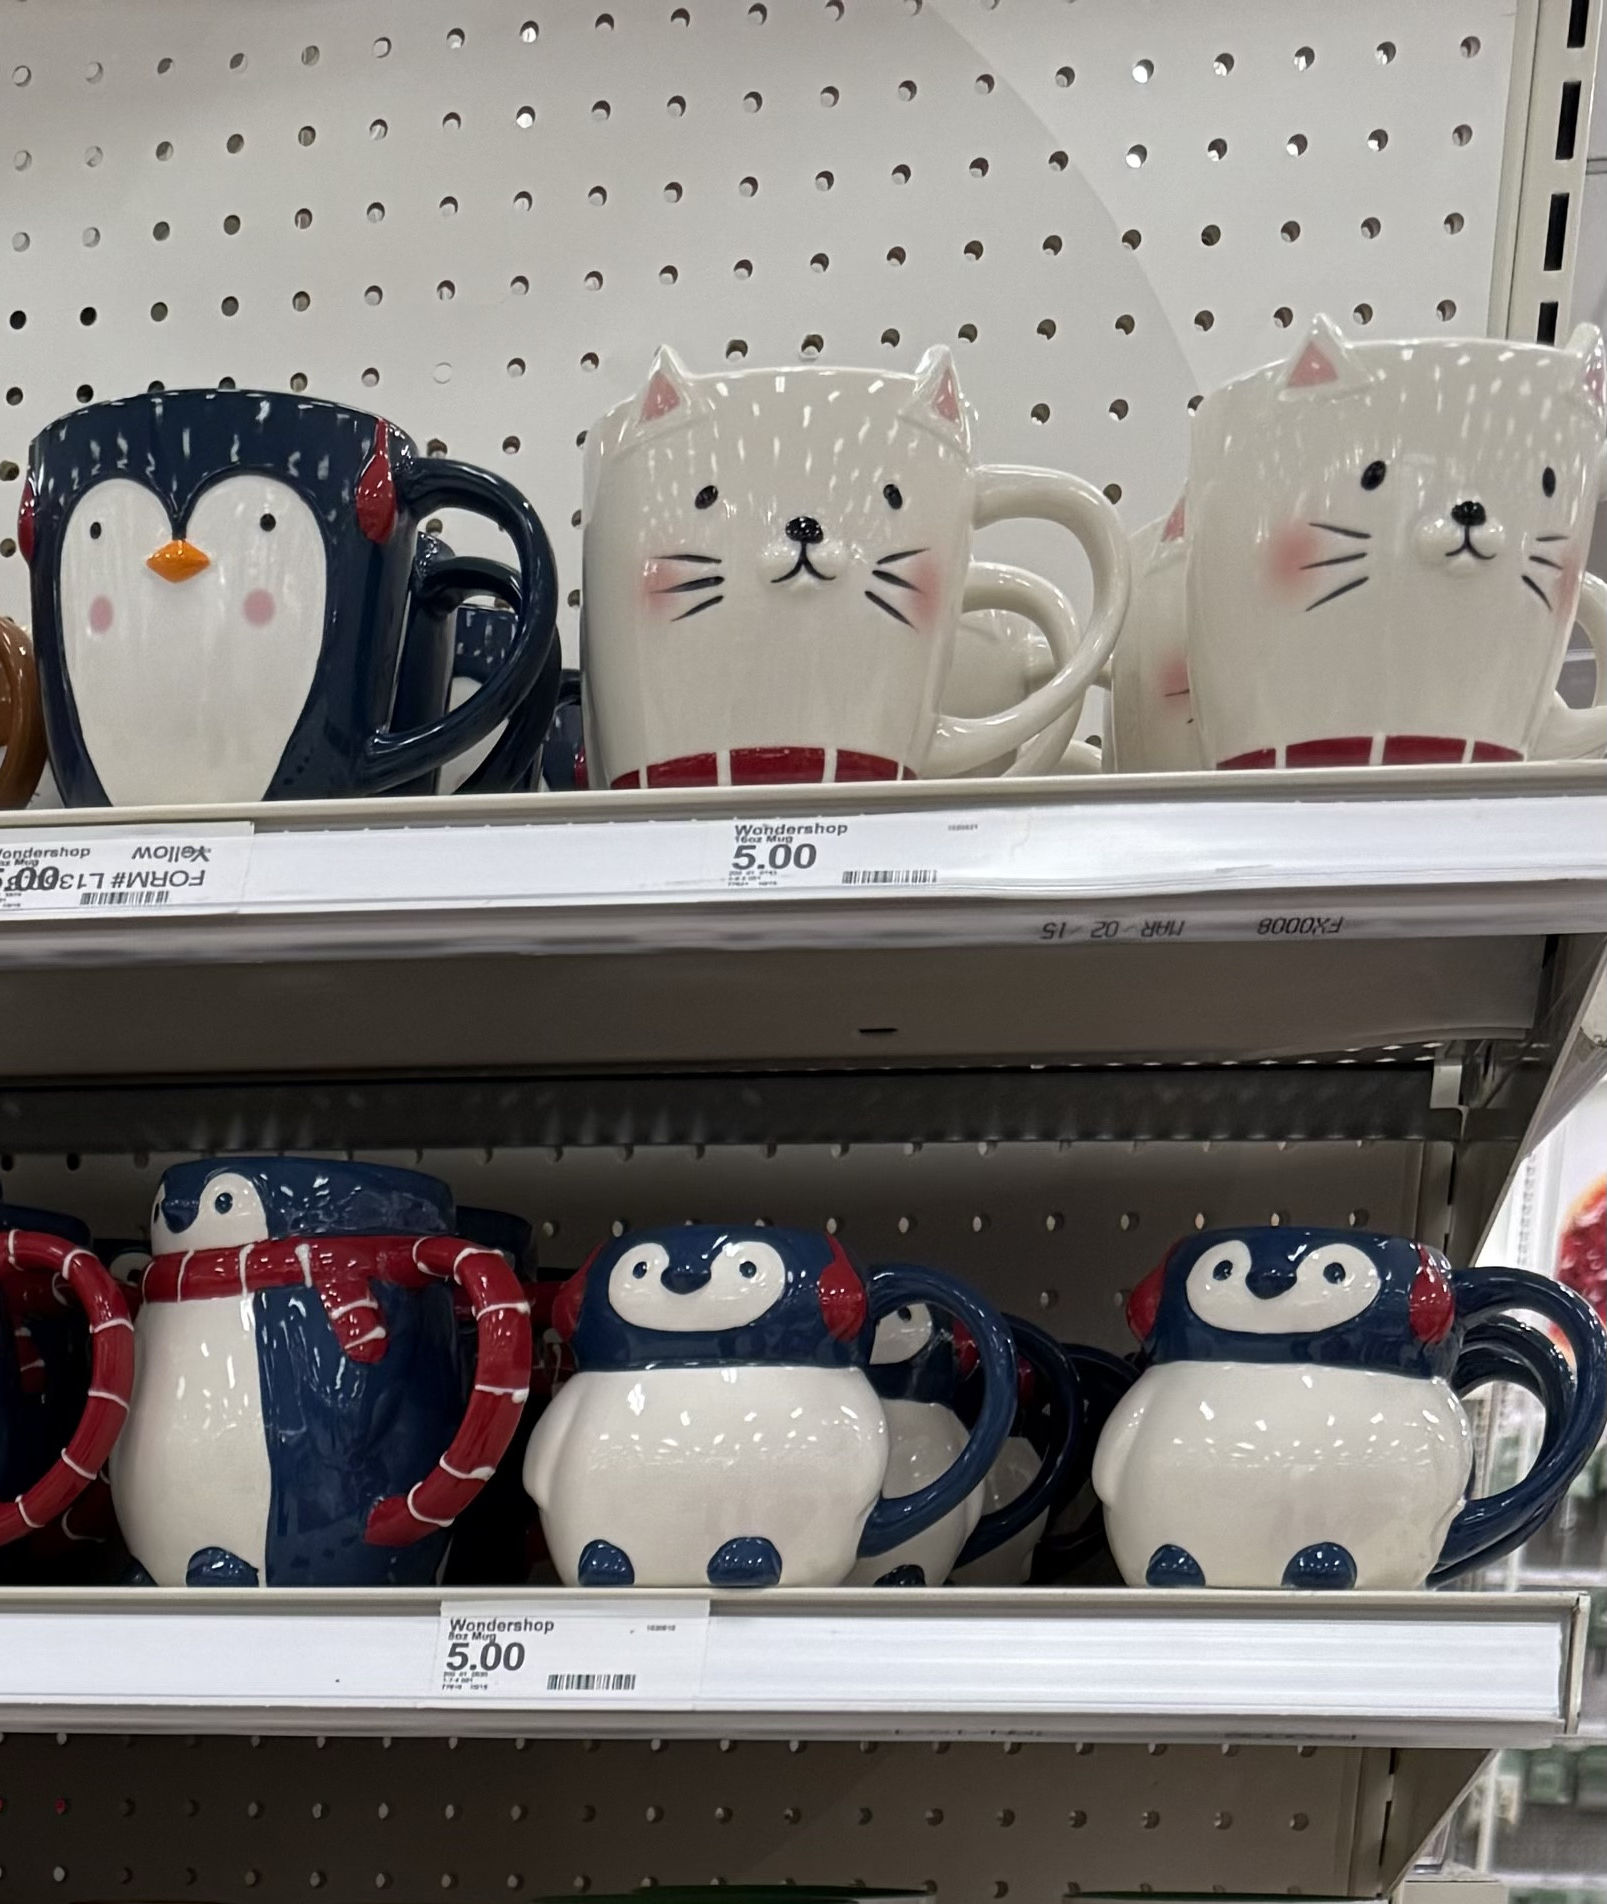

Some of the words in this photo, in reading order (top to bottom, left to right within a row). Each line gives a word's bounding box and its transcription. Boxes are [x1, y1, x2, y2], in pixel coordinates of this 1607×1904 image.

[735, 823, 847, 836] Wondershop
[731, 843, 816, 870] 5.00
[110, 869, 205, 888] FORM#
[1040, 921, 1066, 940] 15
[1089, 921, 1118, 939] 02
[1140, 920, 1185, 938] MAR
[1256, 915, 1344, 935] FX0008
[450, 1618, 553, 1634] Wondershop
[472, 1632, 496, 1642] Mug
[446, 1642, 524, 1671] 5.00
